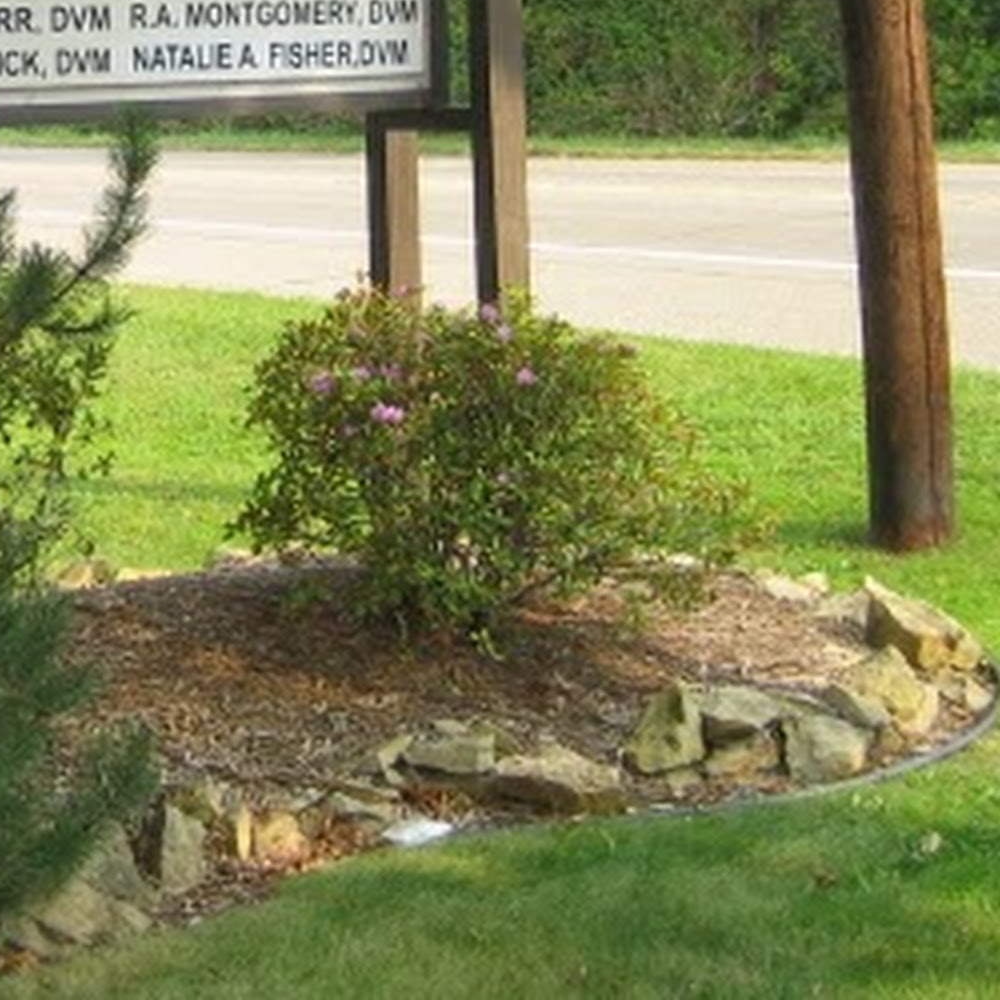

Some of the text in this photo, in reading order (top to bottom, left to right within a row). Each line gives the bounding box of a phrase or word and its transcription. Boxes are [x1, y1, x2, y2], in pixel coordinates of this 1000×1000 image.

[50, 5, 111, 33] DVM
[55, 48, 111, 76] DVM
[132, 42, 233, 72] NATALIE
